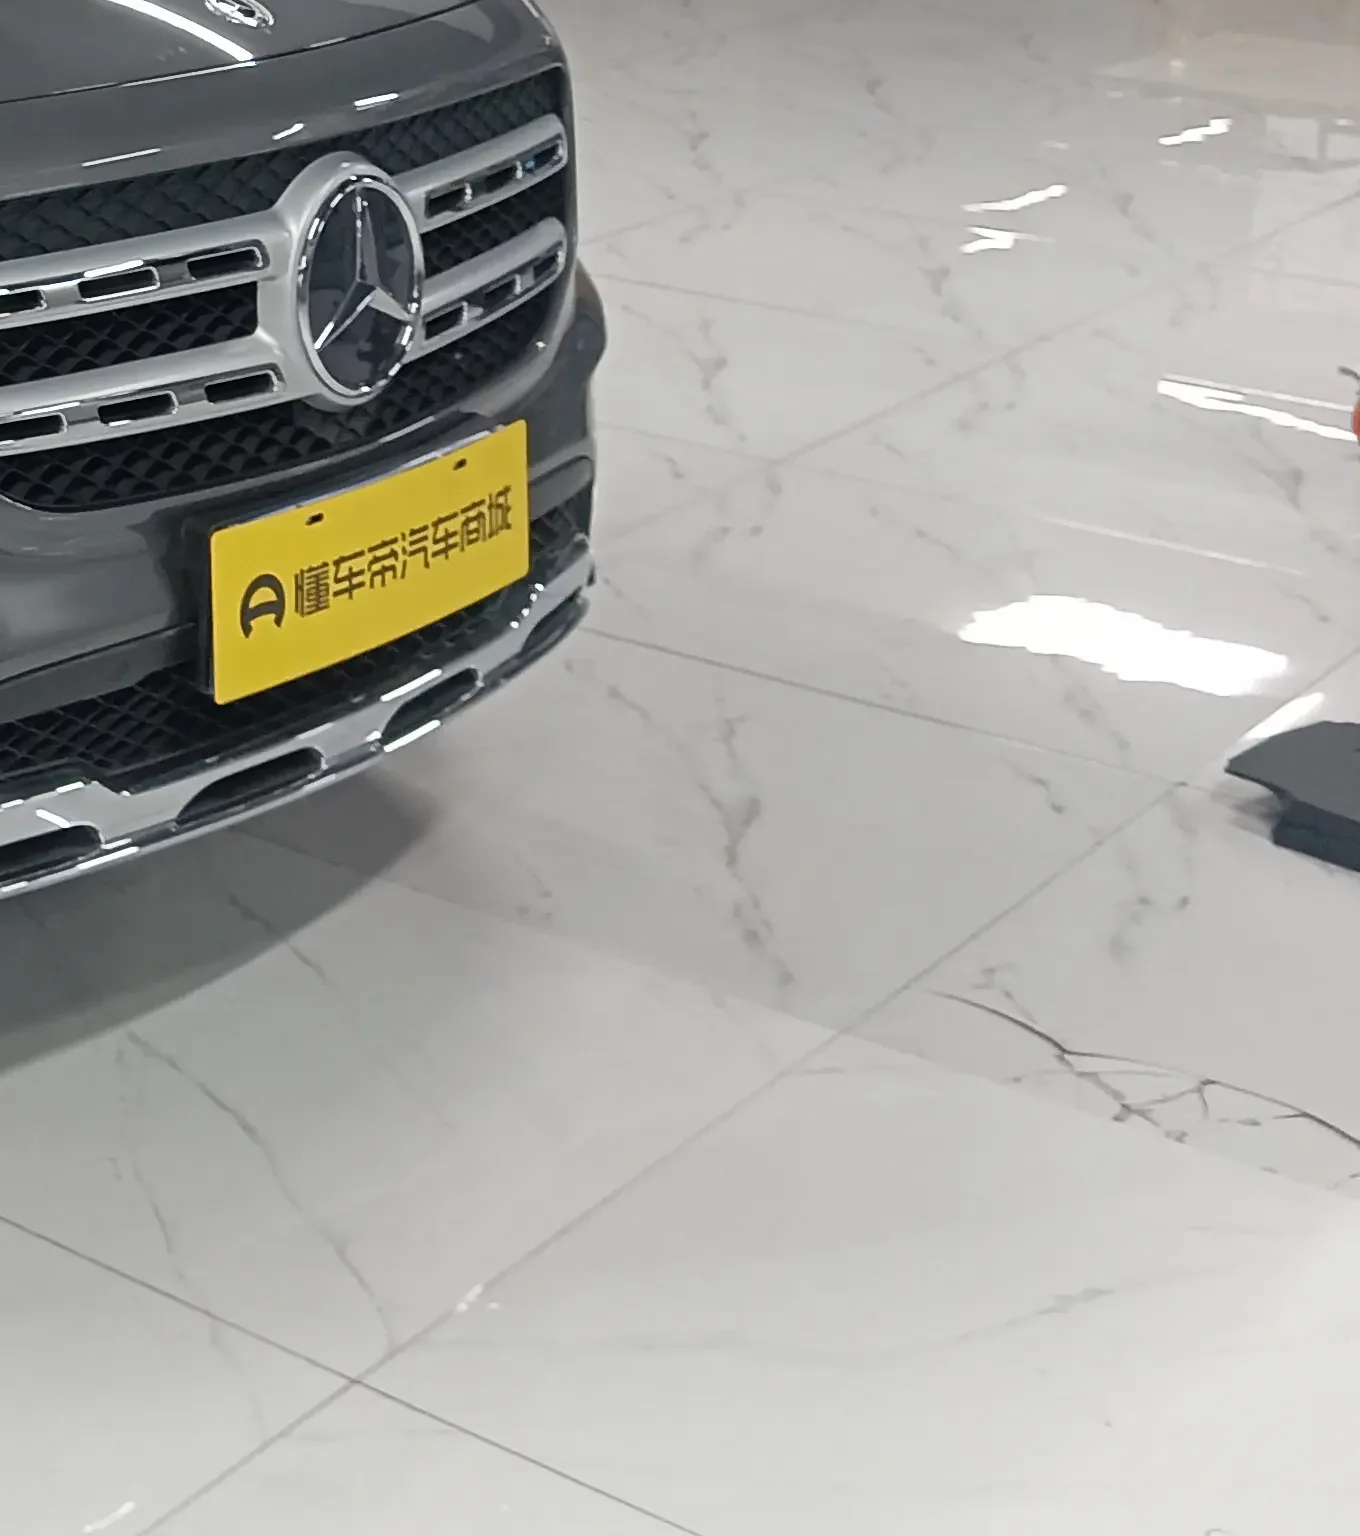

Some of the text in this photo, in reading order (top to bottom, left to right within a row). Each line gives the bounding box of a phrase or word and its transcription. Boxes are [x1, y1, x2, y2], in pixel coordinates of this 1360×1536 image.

[294, 484, 513, 618] 懂车帝汽车商城
